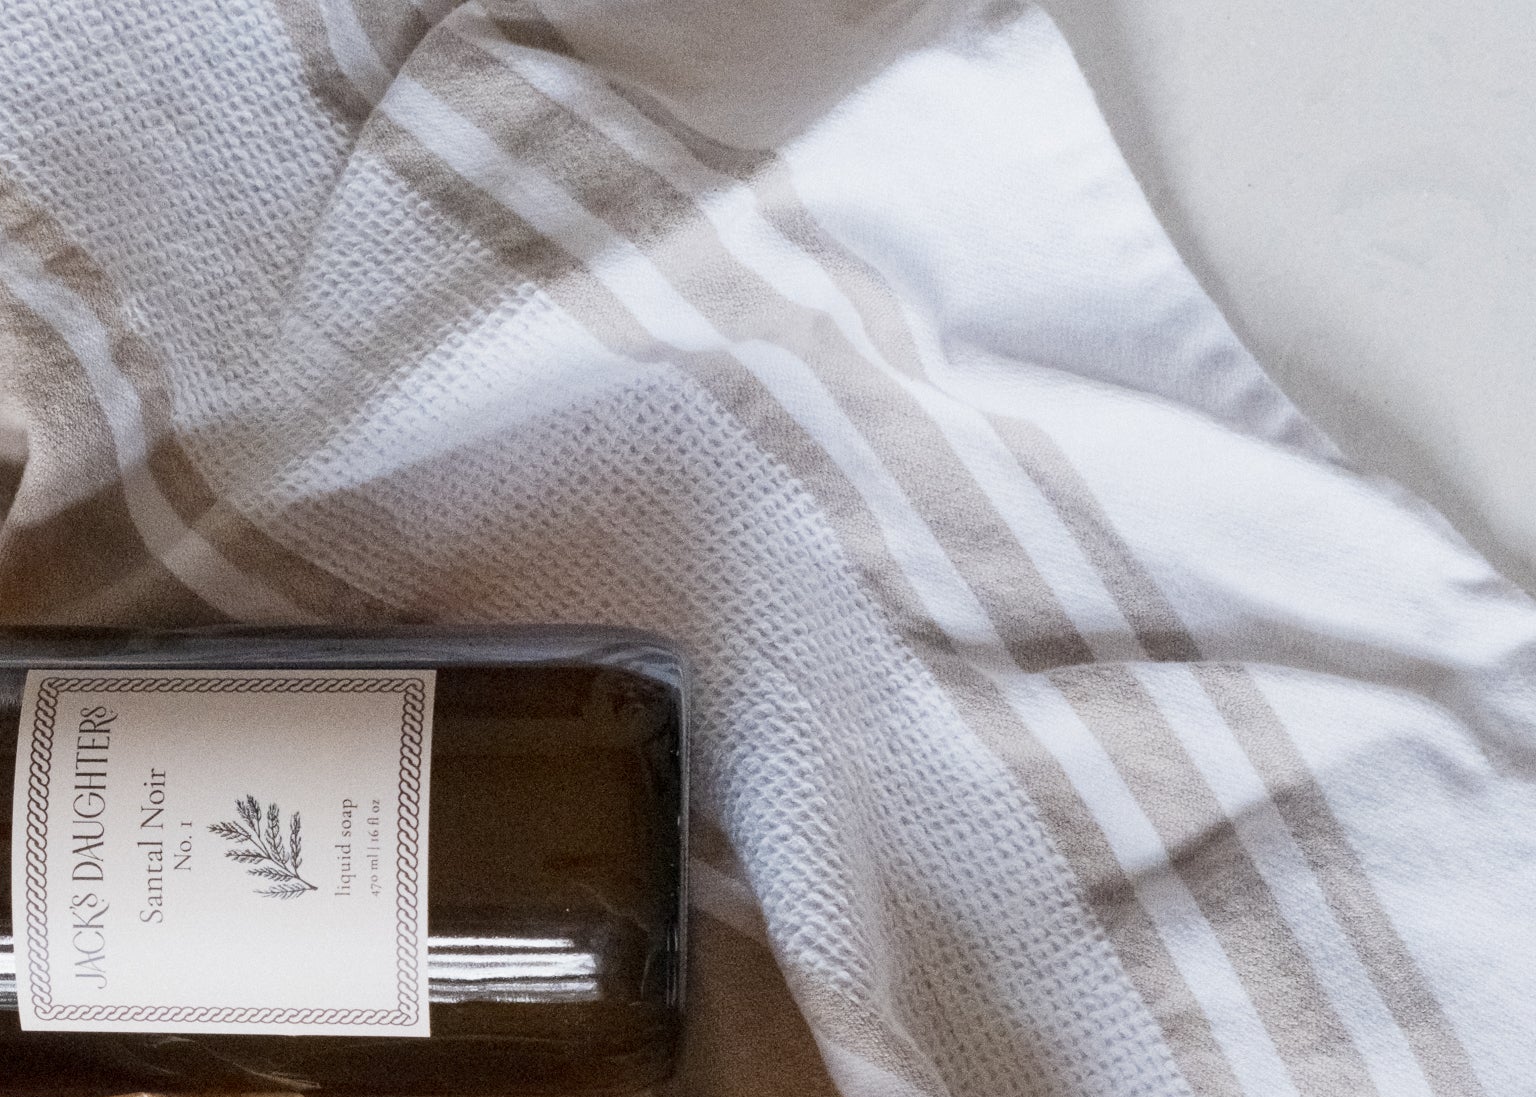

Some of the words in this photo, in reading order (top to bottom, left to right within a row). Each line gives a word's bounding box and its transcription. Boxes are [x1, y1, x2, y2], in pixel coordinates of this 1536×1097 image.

[71, 705, 118, 883] DAUGHTERS
[140, 768, 167, 830] Noir
[371, 799, 381, 813] oz
[341, 798, 358, 838] soap
[173, 835, 193, 871] No.
[334, 843, 357, 896] liquid
[366, 854, 379, 870] ml
[137, 841, 164, 924] Santal
[370, 874, 382, 897] 470
[70, 893, 110, 990] JACK'S
